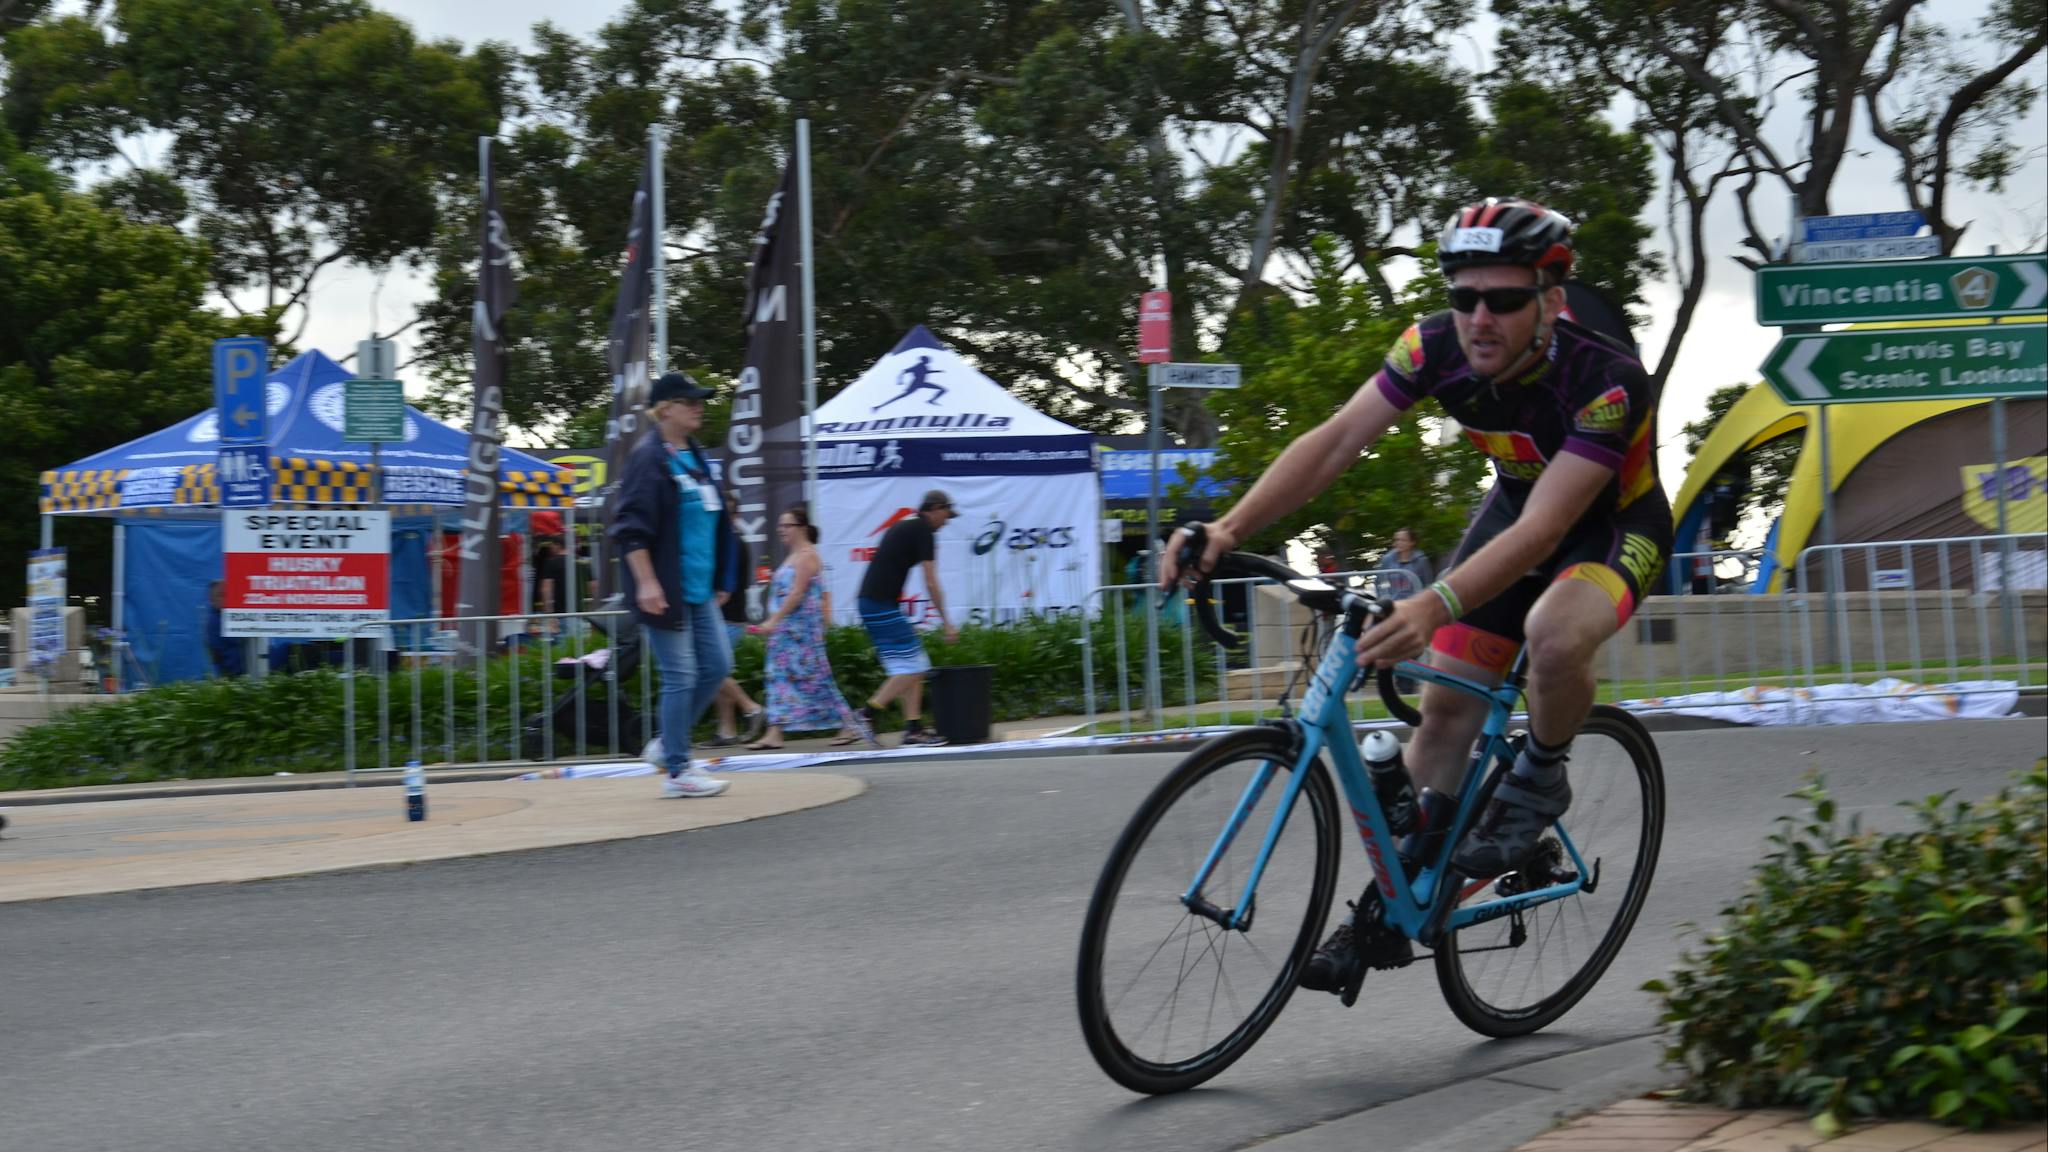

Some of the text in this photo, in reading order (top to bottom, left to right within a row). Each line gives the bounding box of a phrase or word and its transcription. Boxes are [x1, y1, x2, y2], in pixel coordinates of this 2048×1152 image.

[1873, 239, 1939, 257] CHURCH
[1777, 274, 1990, 308] Vincentia 4
[1862, 338, 2026, 362] Jervis Bay
[226, 348, 257, 394] P
[1839, 370, 1930, 391] Scenic
[383, 476, 465, 494] RESCUE
[246, 515, 368, 531] SPECIAL
[262, 534, 352, 549] EVENT
[268, 557, 343, 572] HUSKY
[247, 576, 366, 590] TRIATHLON
